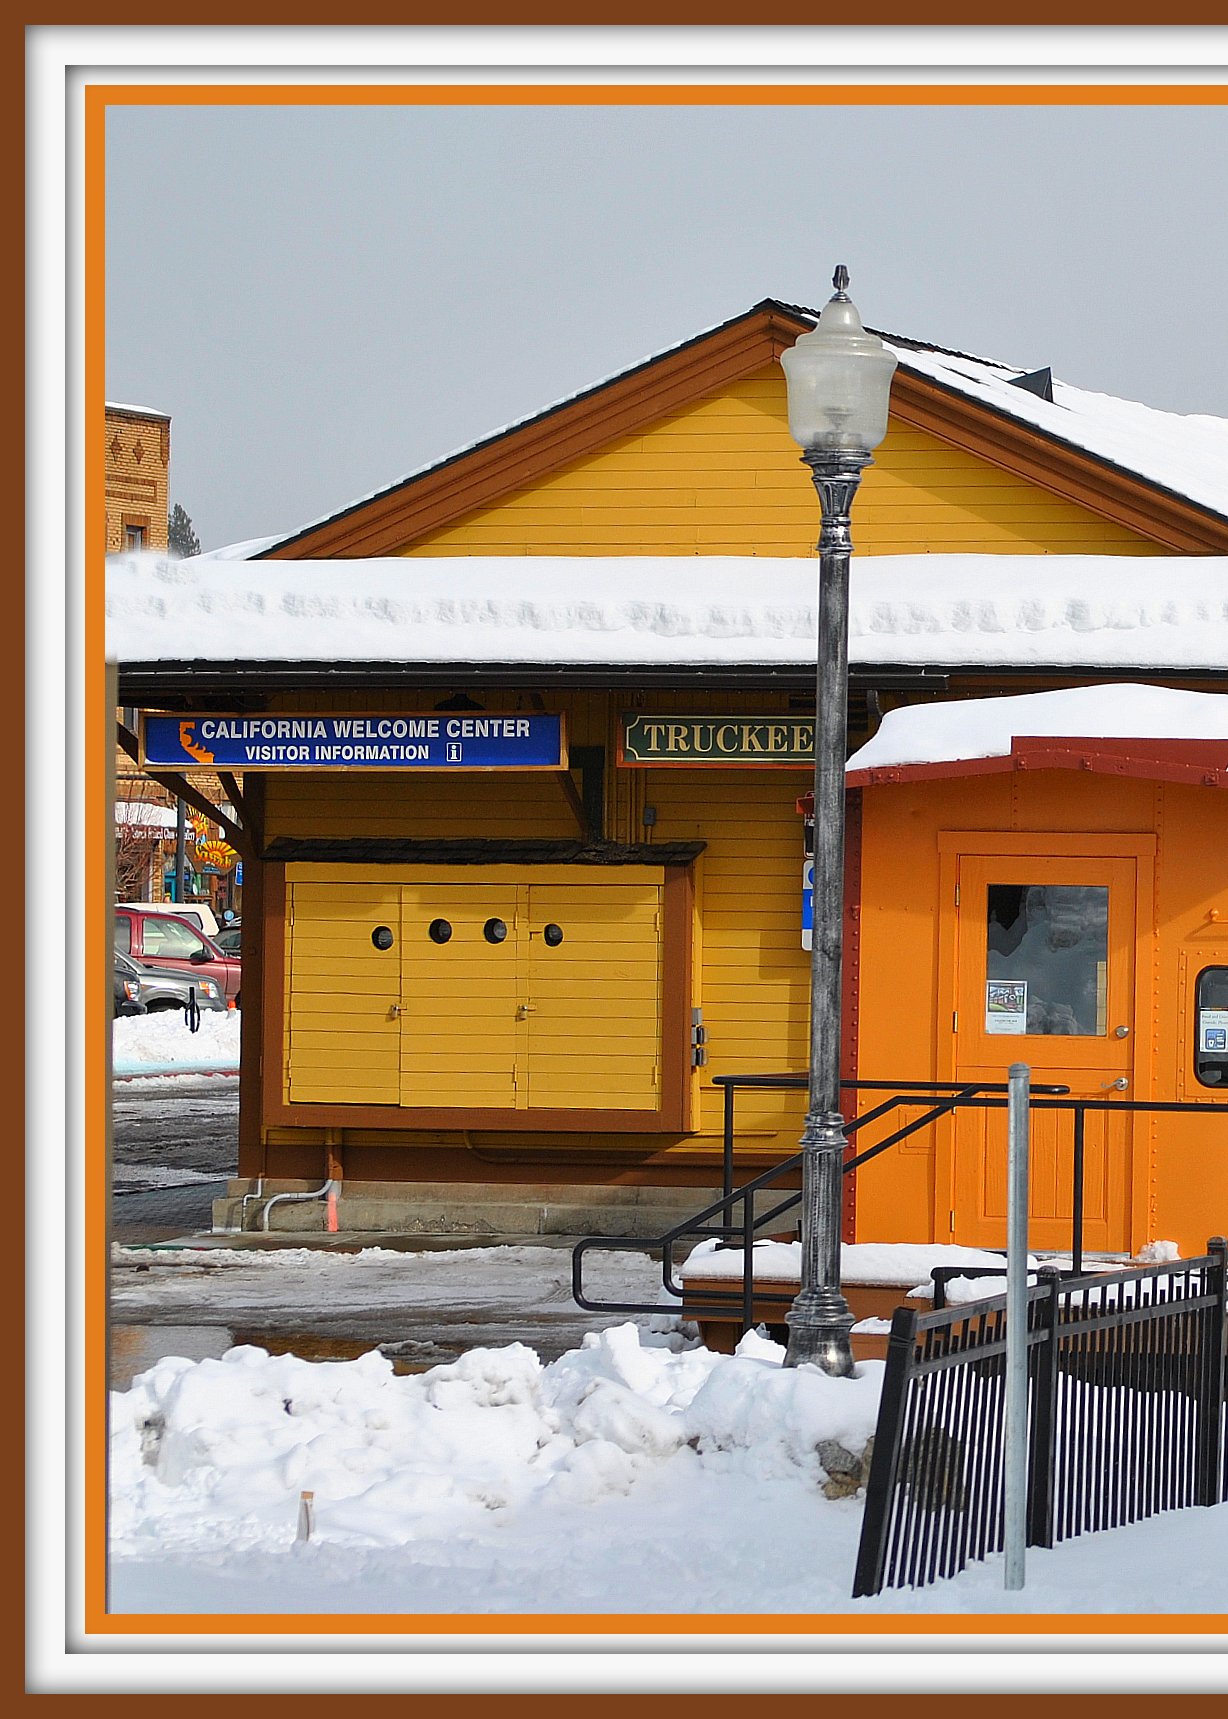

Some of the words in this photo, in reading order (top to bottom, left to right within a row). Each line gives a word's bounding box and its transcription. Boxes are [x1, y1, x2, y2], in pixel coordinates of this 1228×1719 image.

[201, 720, 328, 739] CALIFORNIA
[333, 719, 440, 739] WELCOME
[446, 719, 530, 738] CENTER
[643, 724, 814, 753] TRUCKEE
[245, 745, 310, 760] VISITOR
[315, 744, 429, 760] INFORMATION
